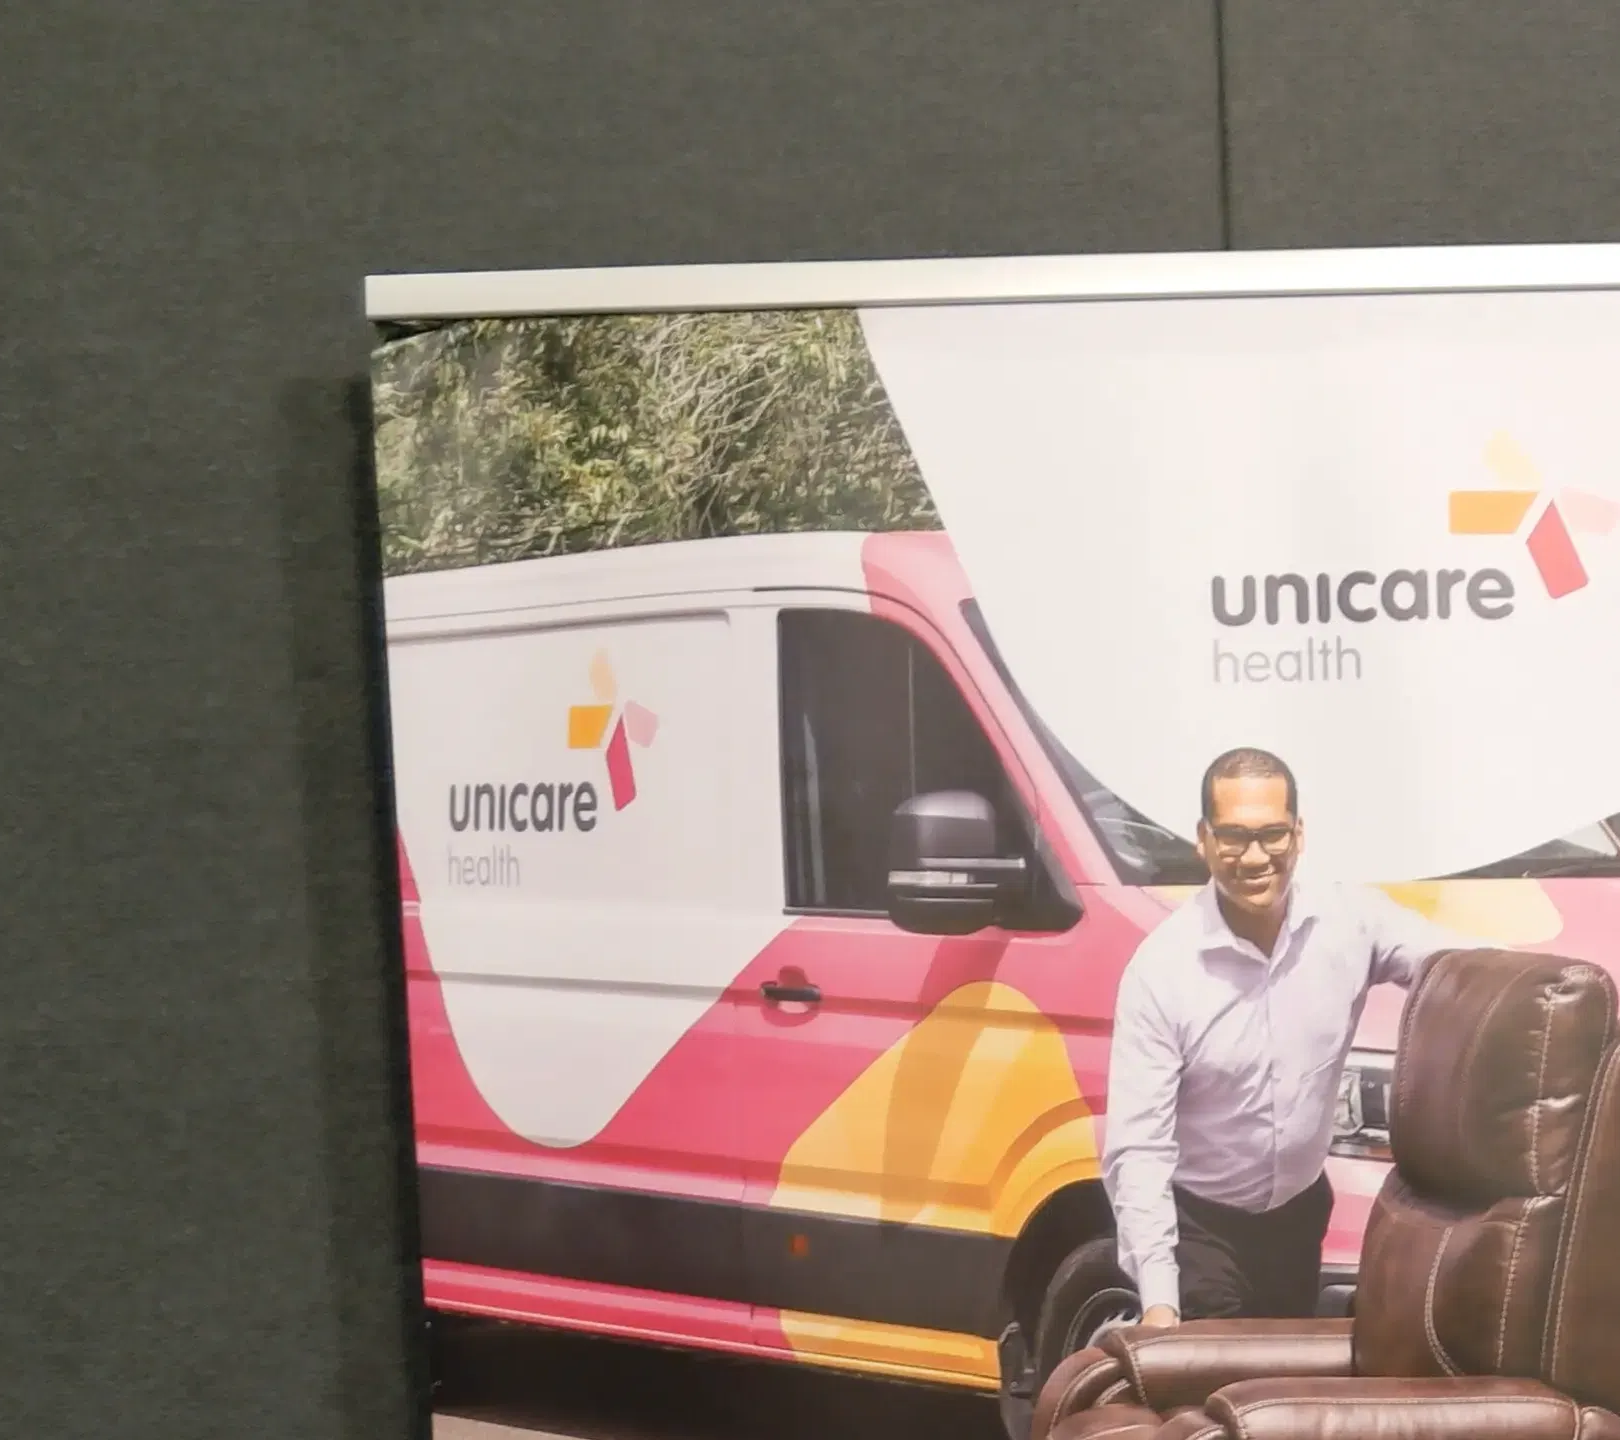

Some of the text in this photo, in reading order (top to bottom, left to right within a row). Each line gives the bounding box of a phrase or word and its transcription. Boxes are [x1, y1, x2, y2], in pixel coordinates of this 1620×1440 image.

[1209, 567, 1516, 627] unicare
[1212, 635, 1363, 685] health
[447, 779, 599, 833] unicare
[445, 844, 521, 889] health
